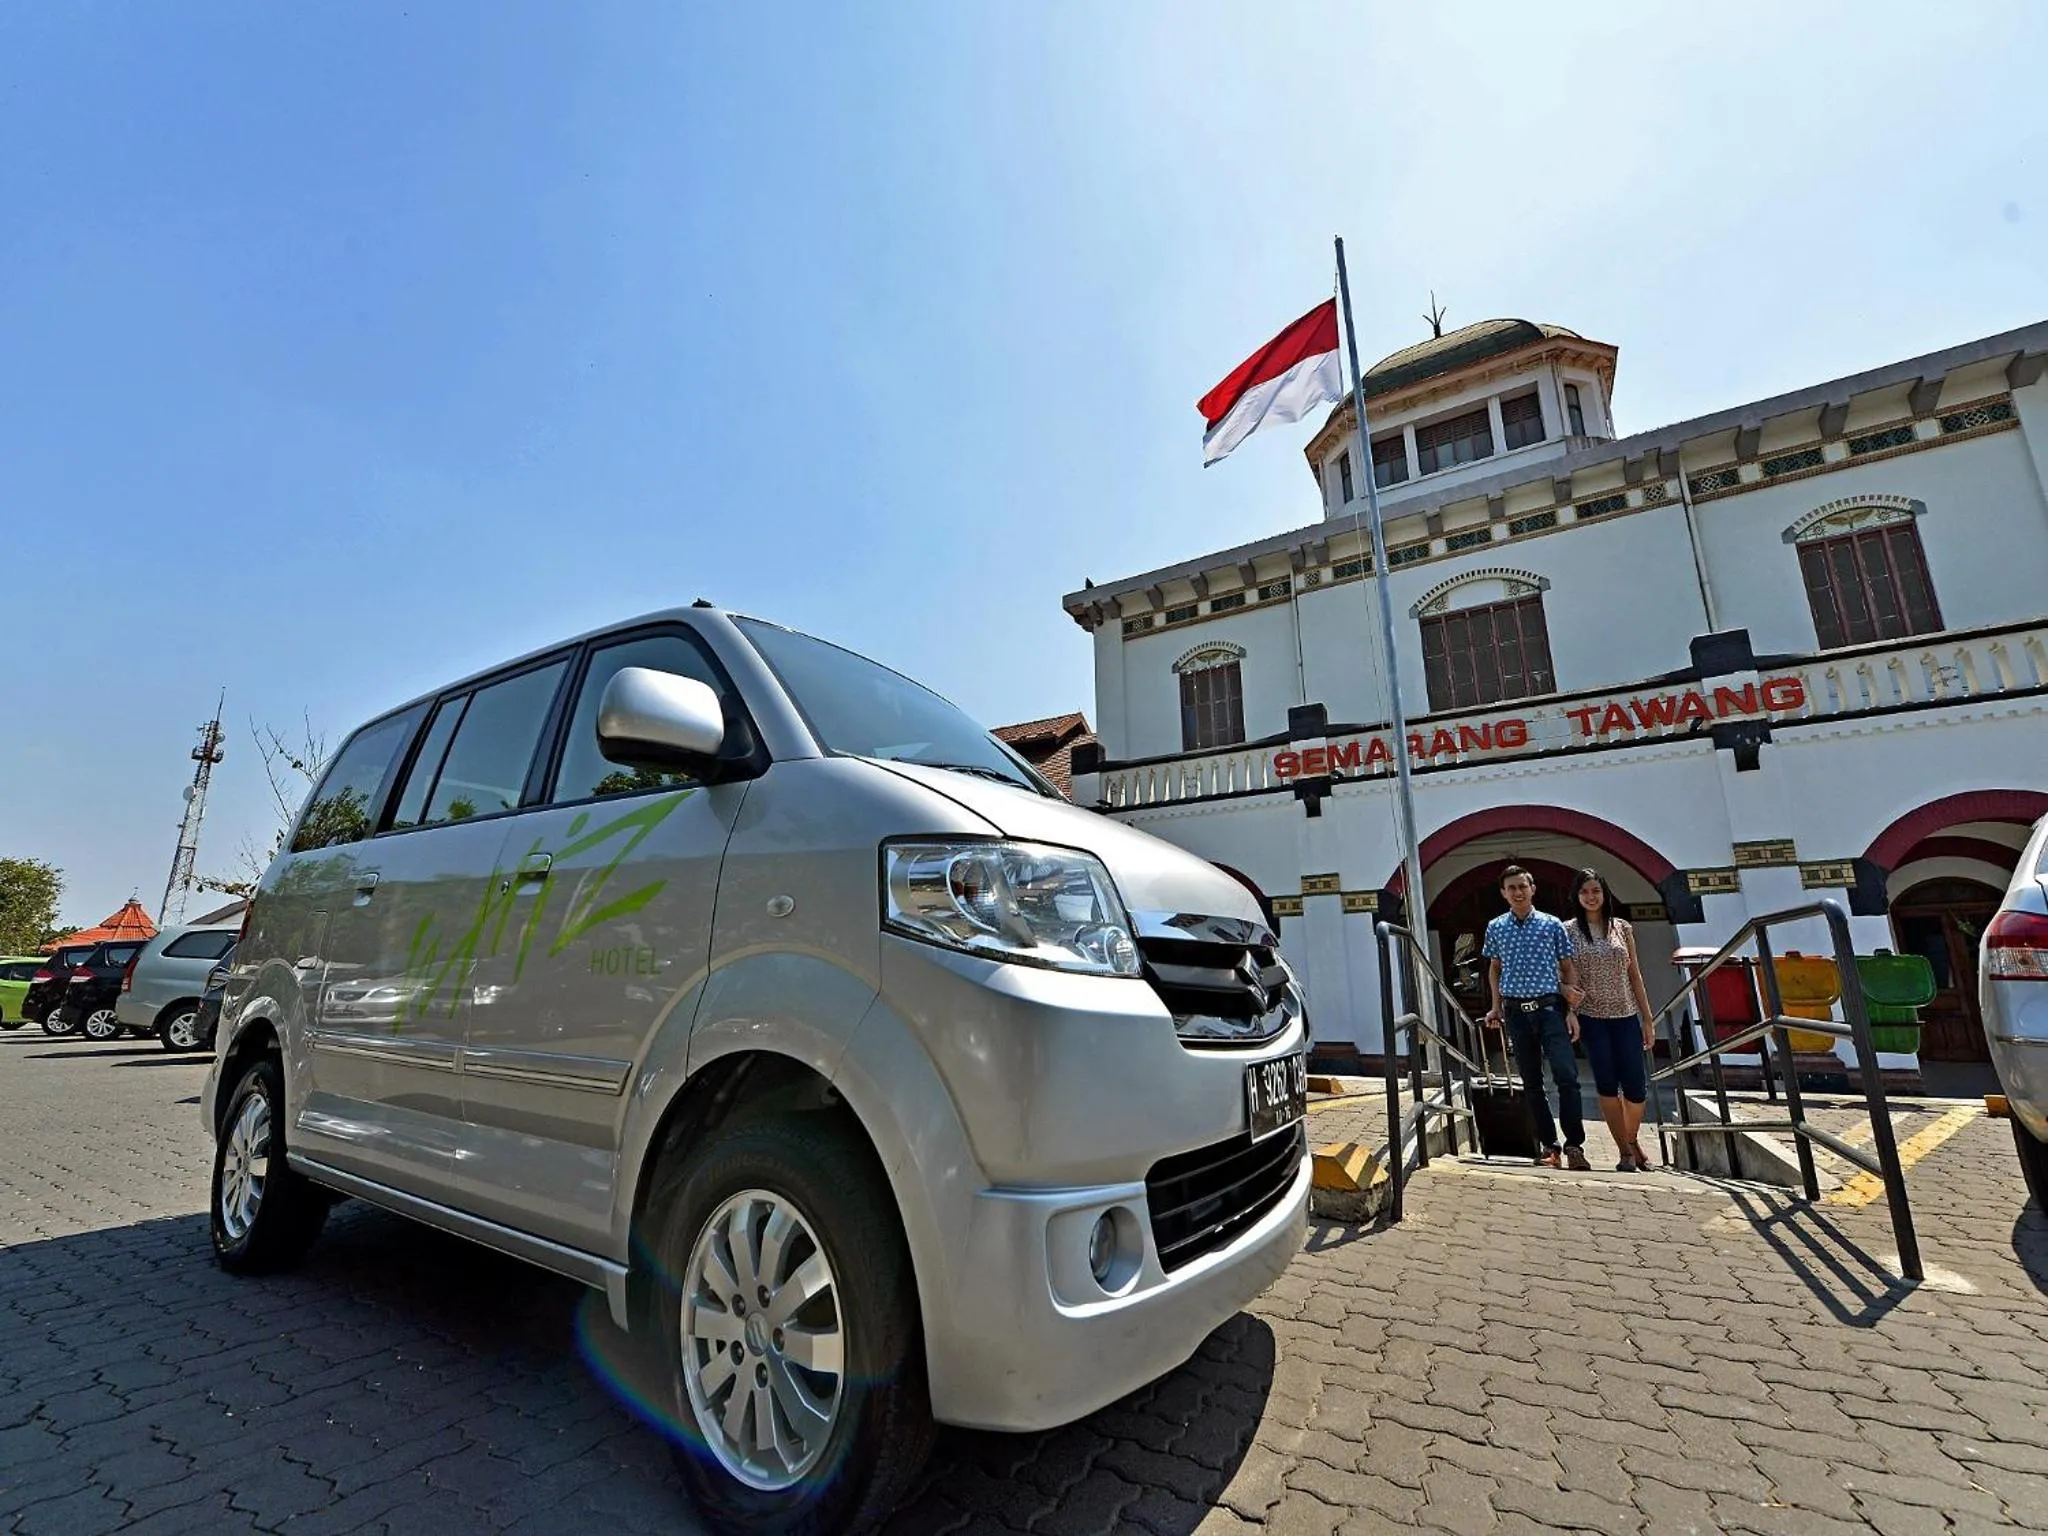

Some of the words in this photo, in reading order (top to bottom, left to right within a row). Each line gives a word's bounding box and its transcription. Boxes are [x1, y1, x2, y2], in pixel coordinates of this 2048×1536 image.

[1273, 718, 1529, 778] SEMARANG
[1566, 677, 1806, 736] TAWANG
[589, 946, 663, 976] HOTEL
[1248, 1067, 1260, 1113] H
